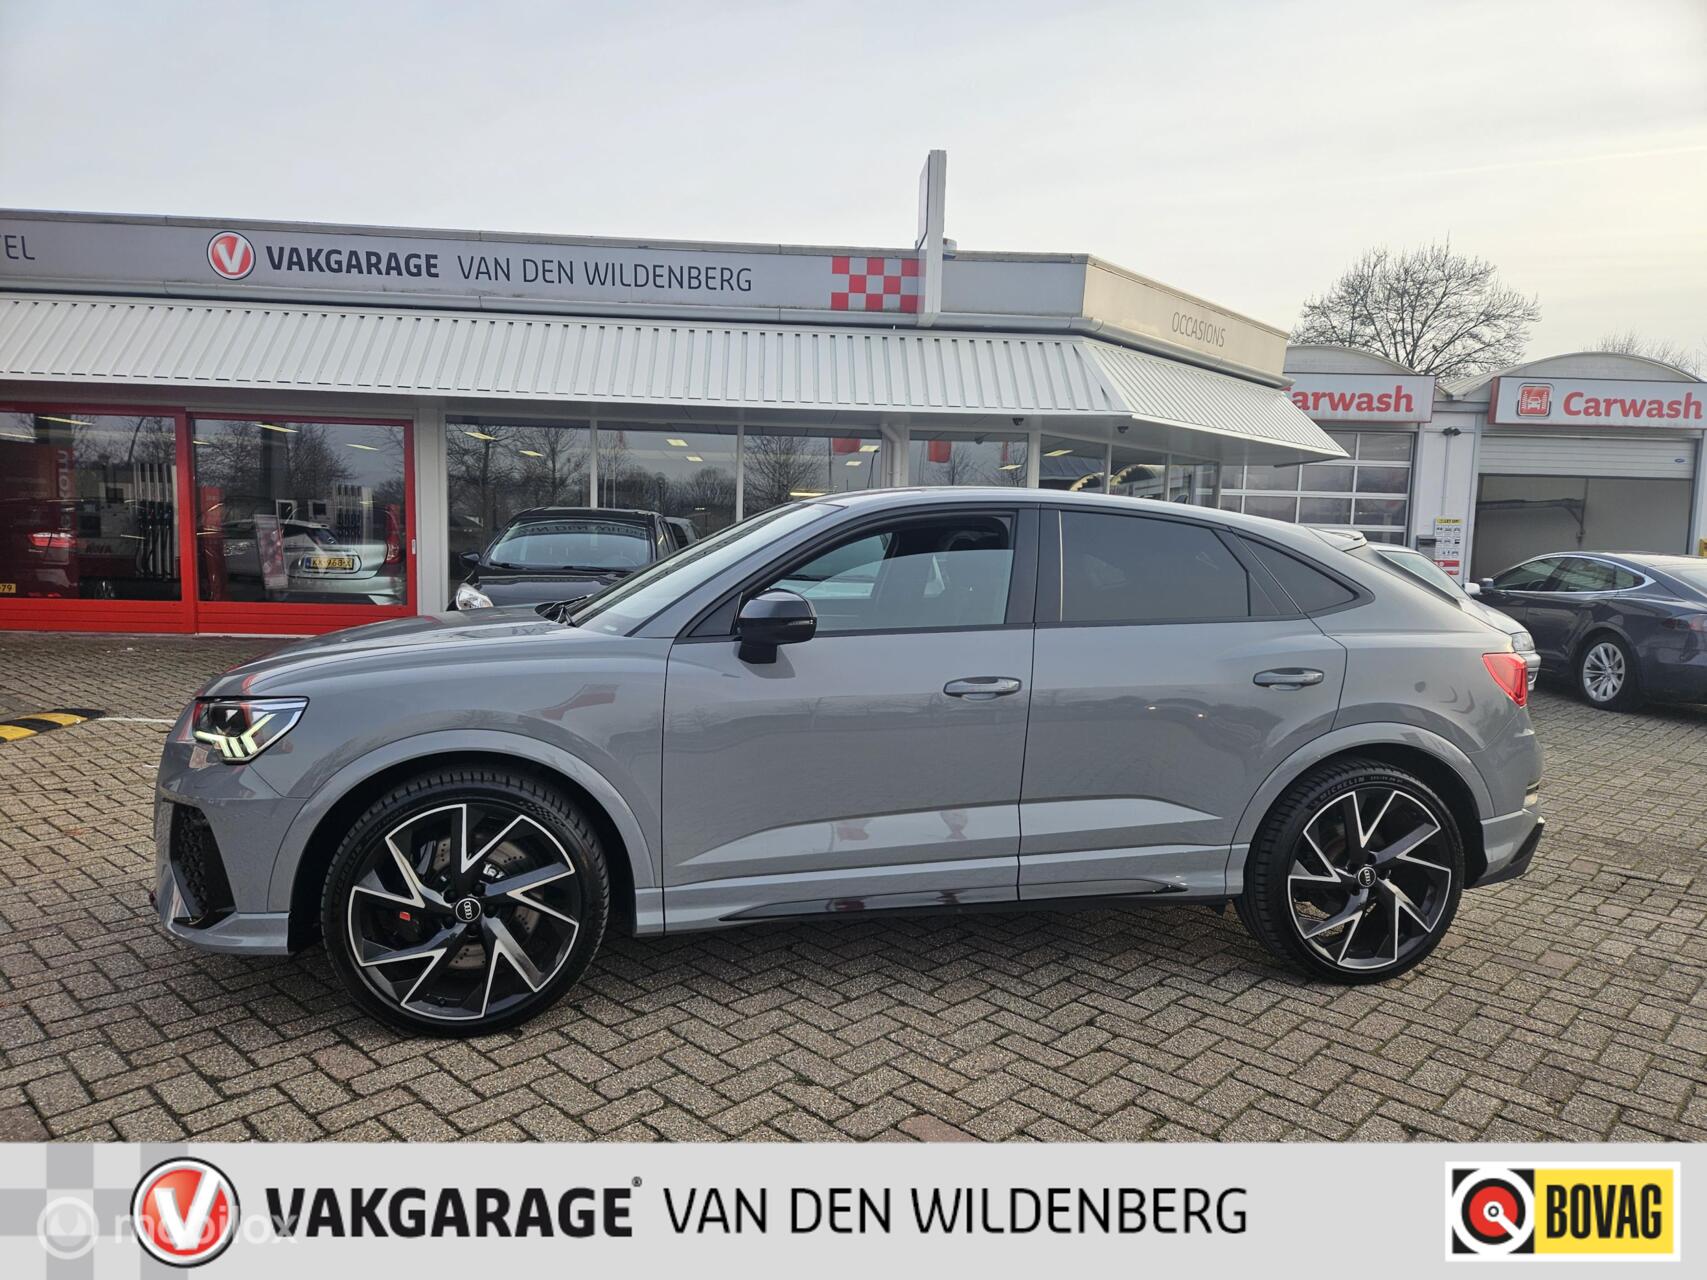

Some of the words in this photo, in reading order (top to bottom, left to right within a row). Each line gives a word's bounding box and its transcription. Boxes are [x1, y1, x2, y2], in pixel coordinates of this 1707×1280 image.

[0, 234, 36, 260] EL
[265, 245, 440, 278] VAKGARAGE
[457, 255, 511, 281] VAN
[522, 258, 574, 285] DEN
[583, 261, 752, 292] WILDENBERG
[1171, 311, 1227, 348] OCCASIONS
[1563, 391, 1703, 419] Carwash
